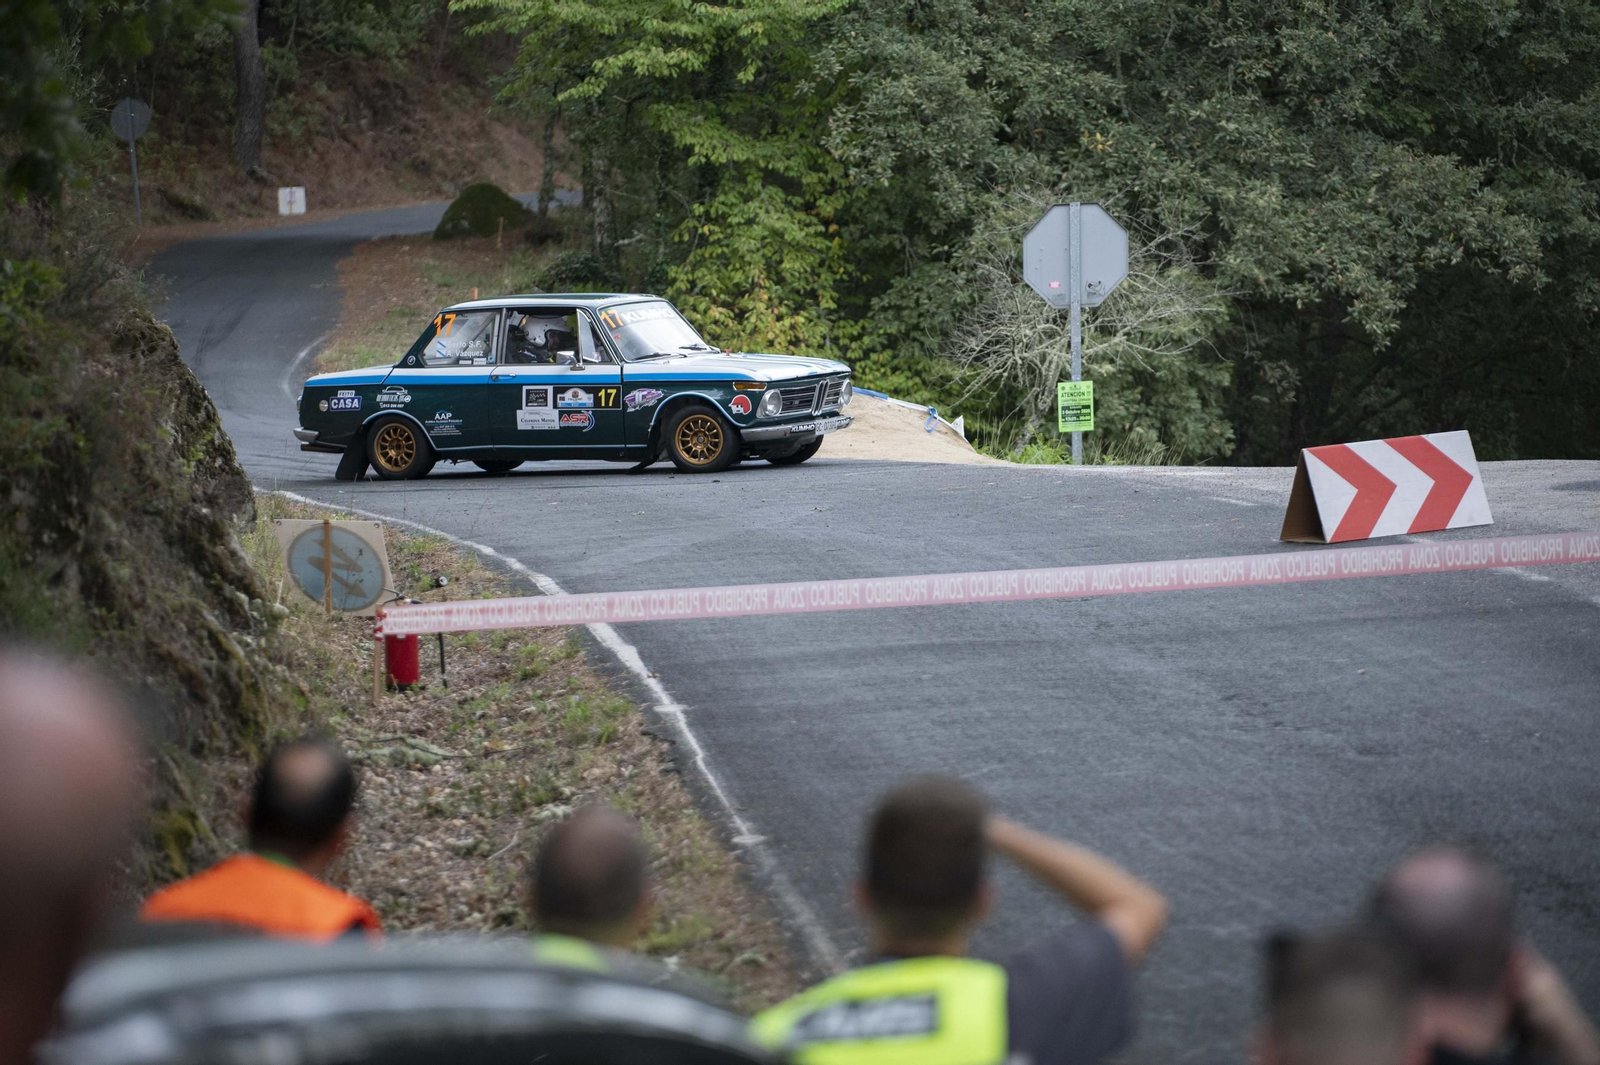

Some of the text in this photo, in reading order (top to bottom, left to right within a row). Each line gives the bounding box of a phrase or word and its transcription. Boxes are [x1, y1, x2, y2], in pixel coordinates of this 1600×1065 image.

[601, 309, 624, 329] 17
[622, 308, 675, 323] KUMHO
[433, 313, 457, 336] 17
[331, 398, 359, 409] CASA
[598, 388, 617, 407] 17
[434, 412, 452, 420] AAP
[560, 413, 589, 423] ASR
[791, 423, 815, 433] KUMHO
